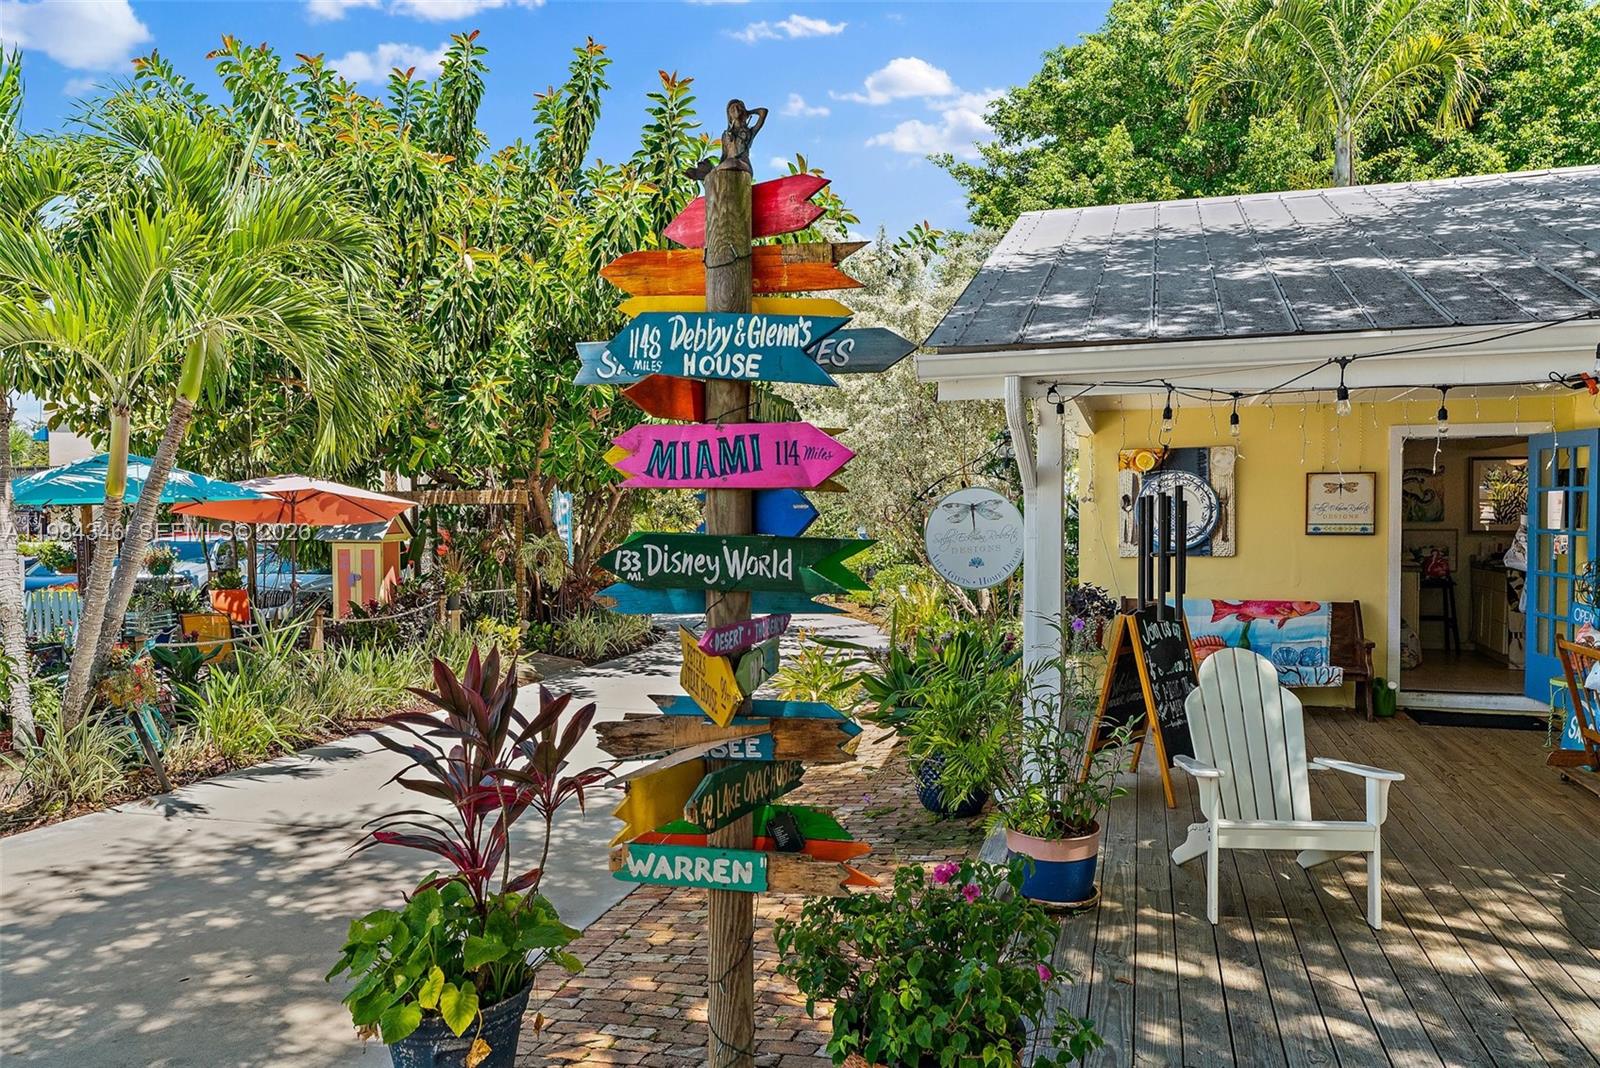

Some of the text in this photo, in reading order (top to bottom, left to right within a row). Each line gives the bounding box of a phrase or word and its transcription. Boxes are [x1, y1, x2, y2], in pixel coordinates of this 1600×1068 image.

[629, 323, 663, 373] 1148 MILES
[668, 315, 733, 358] Debby
[747, 316, 812, 349] Glenn's
[683, 352, 762, 378] HOUSE
[643, 433, 834, 480] MIAMI 114 Miles
[615, 550, 642, 572] 133
[643, 544, 721, 585] Disney
[716, 783, 741, 819] LAKE
